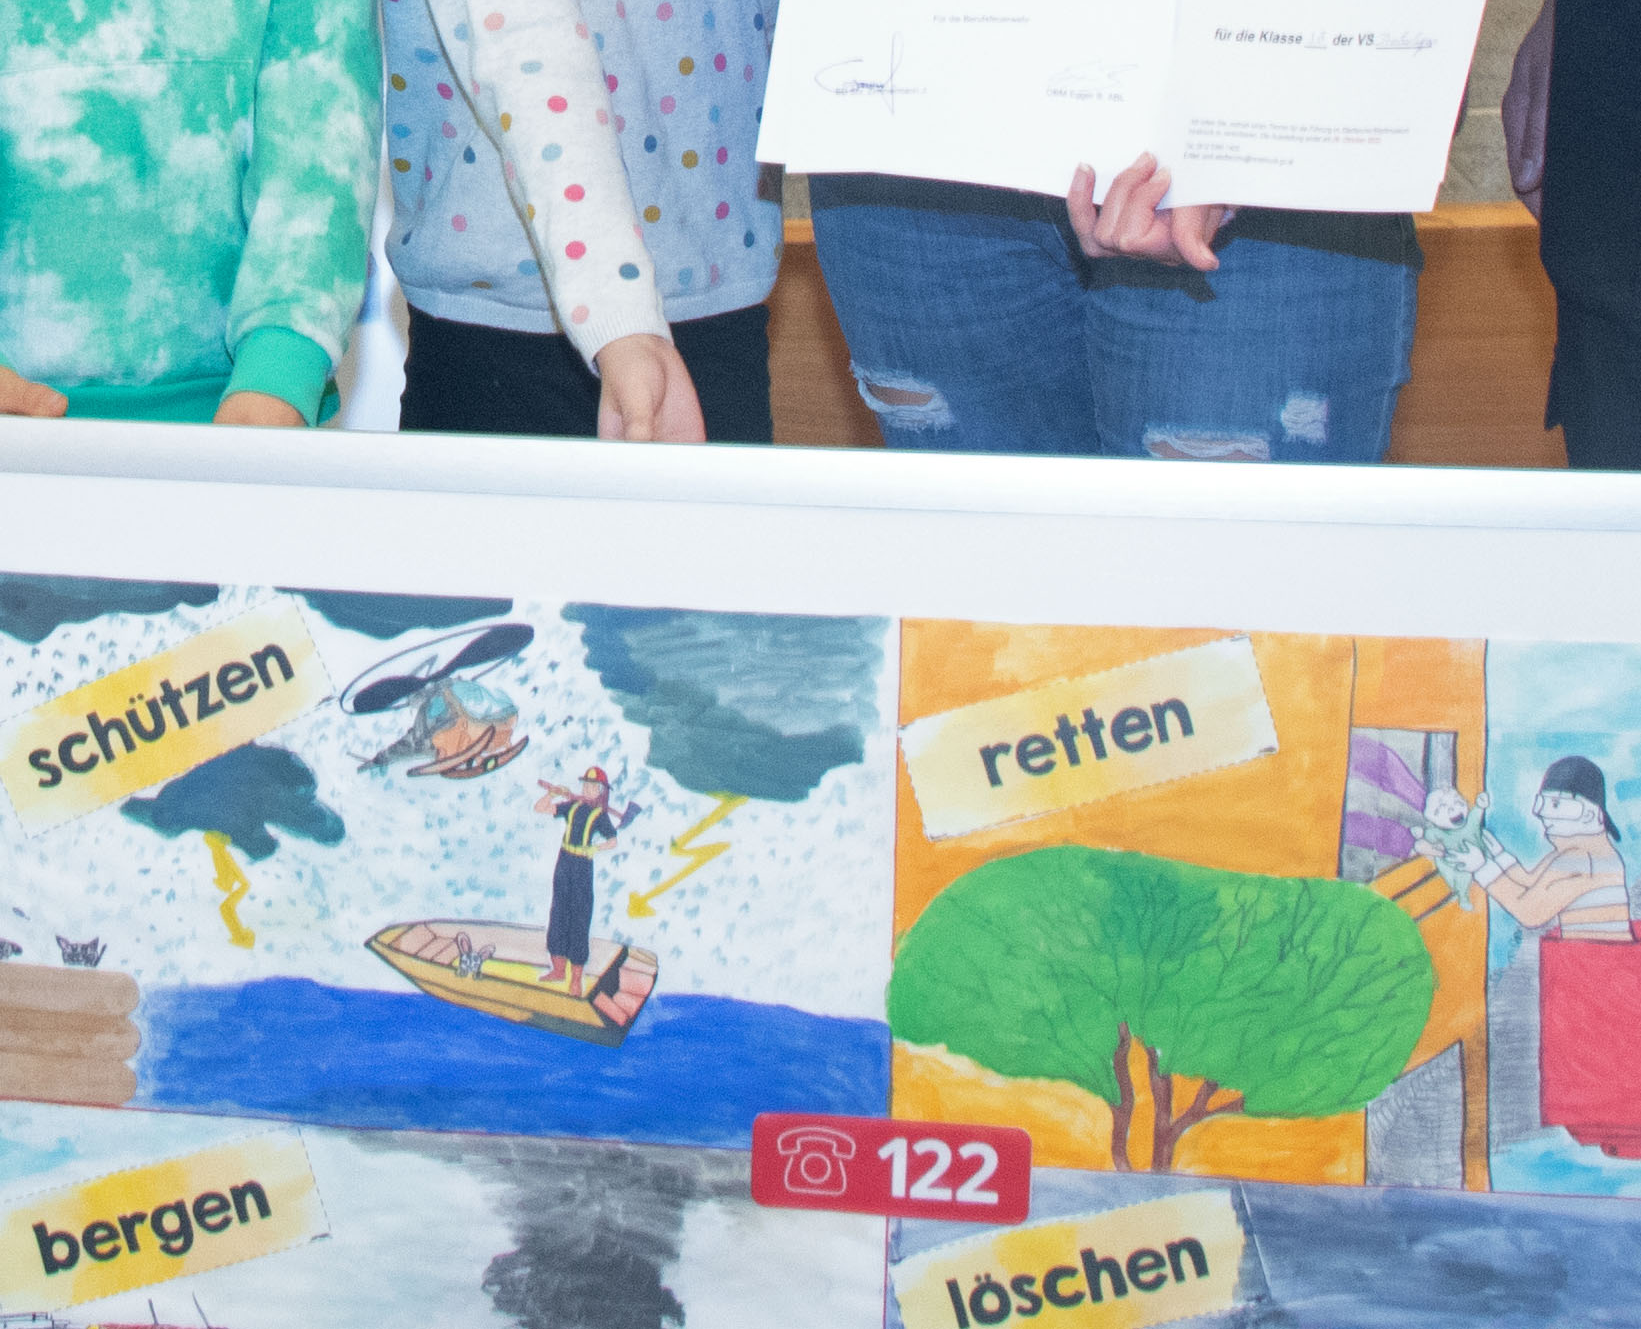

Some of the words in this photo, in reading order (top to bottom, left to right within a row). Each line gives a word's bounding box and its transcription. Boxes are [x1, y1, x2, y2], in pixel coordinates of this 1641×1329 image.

[1214, 27, 1232, 42] für
[1235, 29, 1255, 43] die
[1258, 30, 1304, 46] Klasse
[1332, 32, 1353, 47] der
[1356, 32, 1375, 47] VS
[26, 638, 296, 790] schützen
[977, 693, 1195, 786] retten
[878, 1134, 1000, 1206] 122
[31, 1173, 273, 1277] bergen
[946, 1231, 1210, 1329] löschen
